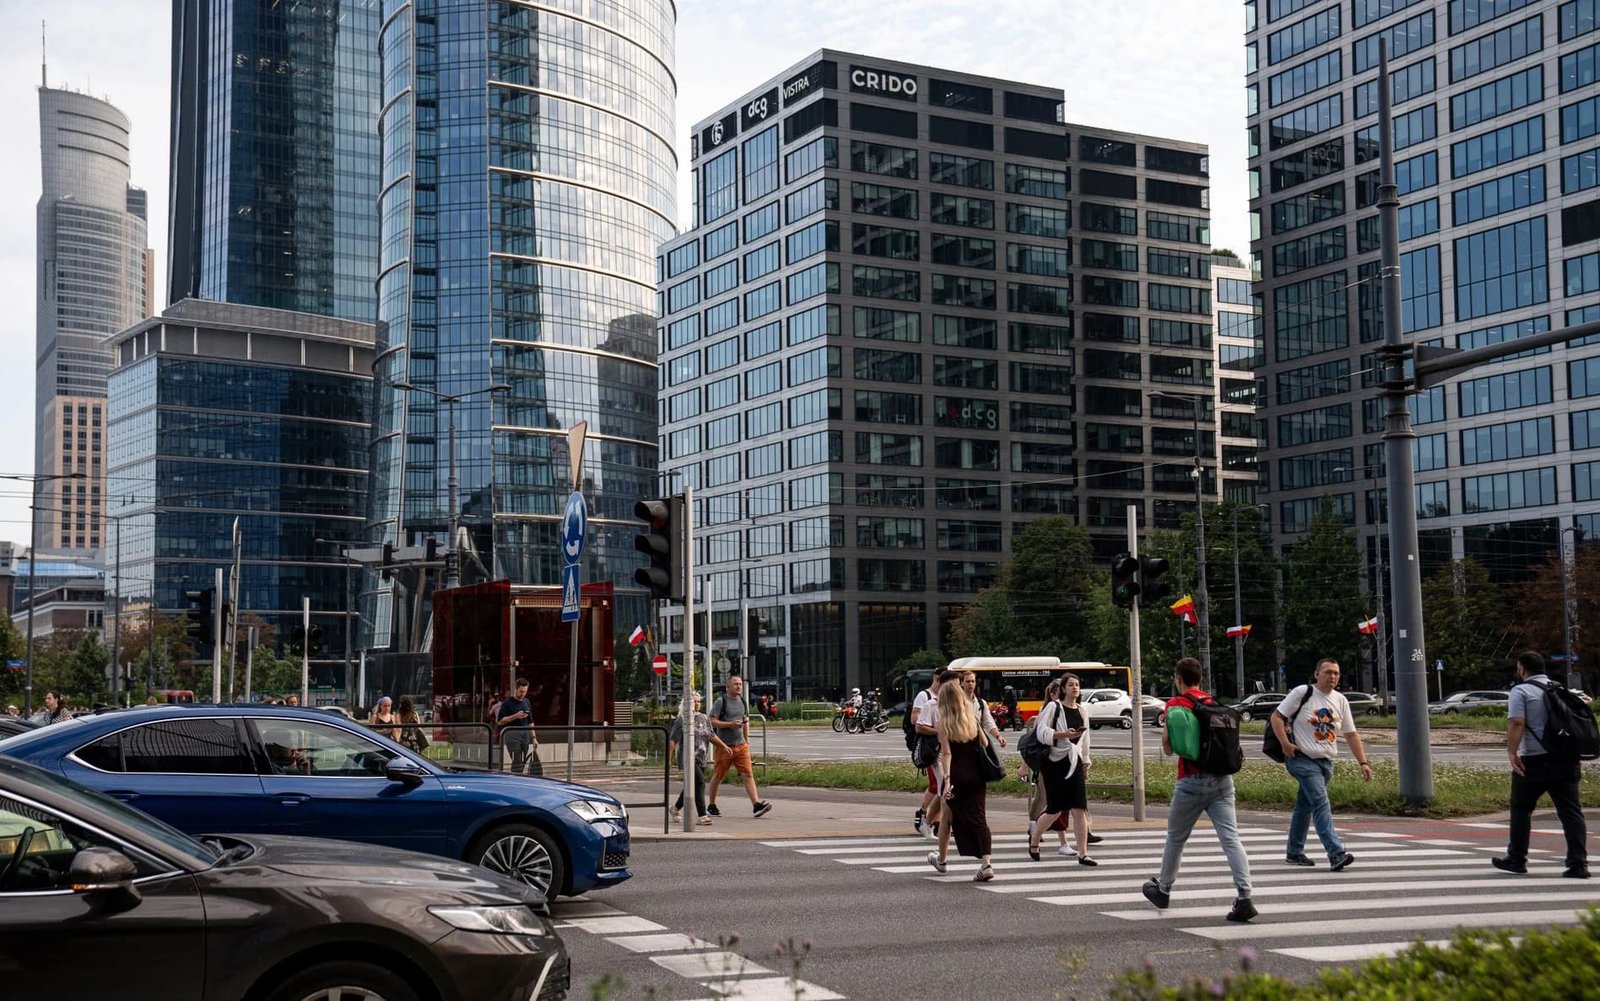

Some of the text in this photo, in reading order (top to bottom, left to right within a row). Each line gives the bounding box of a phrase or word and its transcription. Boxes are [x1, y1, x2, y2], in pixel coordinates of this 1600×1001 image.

[783, 75, 810, 99] VISTRA
[851, 69, 917, 95] CRIDO
[748, 97, 768, 119] dcg
[961, 403, 997, 429] dcg
